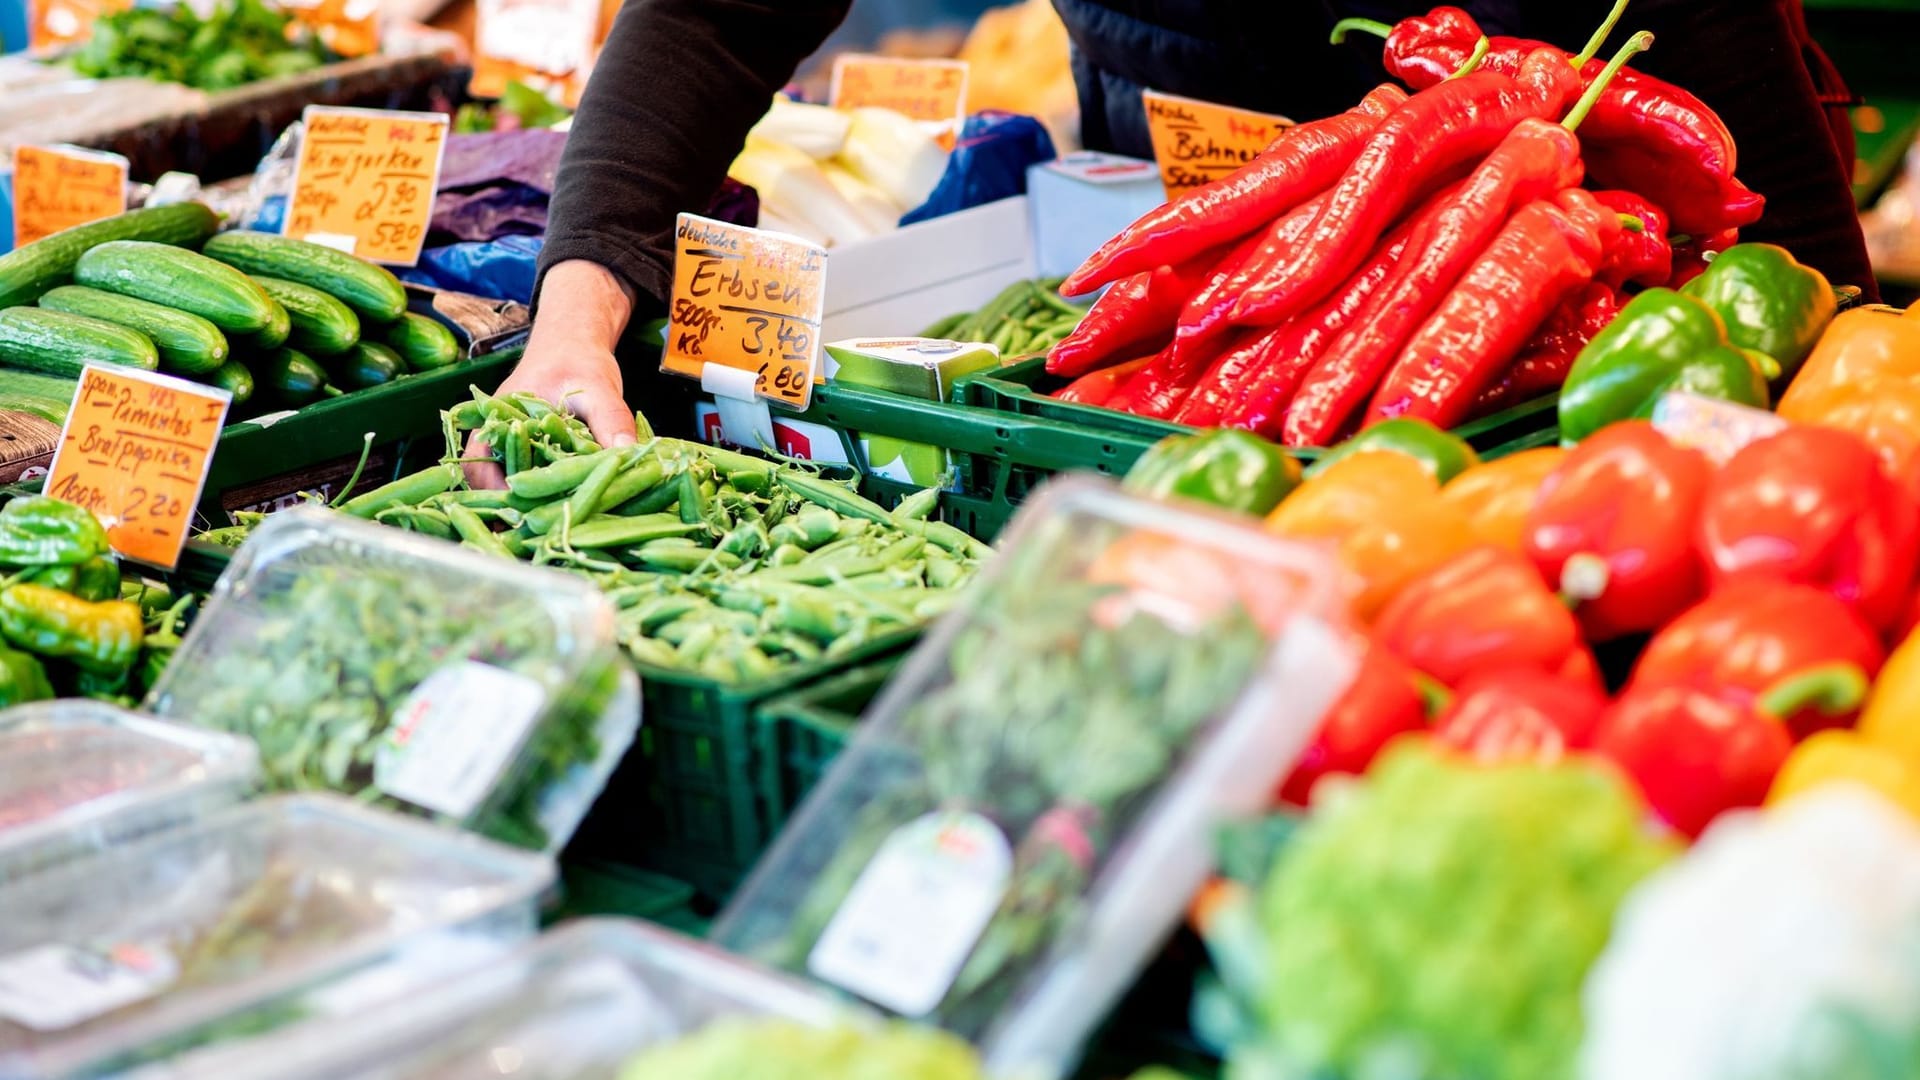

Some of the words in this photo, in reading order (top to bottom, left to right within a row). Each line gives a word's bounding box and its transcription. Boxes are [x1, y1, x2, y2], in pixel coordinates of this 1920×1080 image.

[677, 219, 738, 251] deutsche
[690, 260, 801, 306] Erbsen
[112, 387, 194, 437] Pimentos
[79, 424, 191, 478] Bratpaprika
